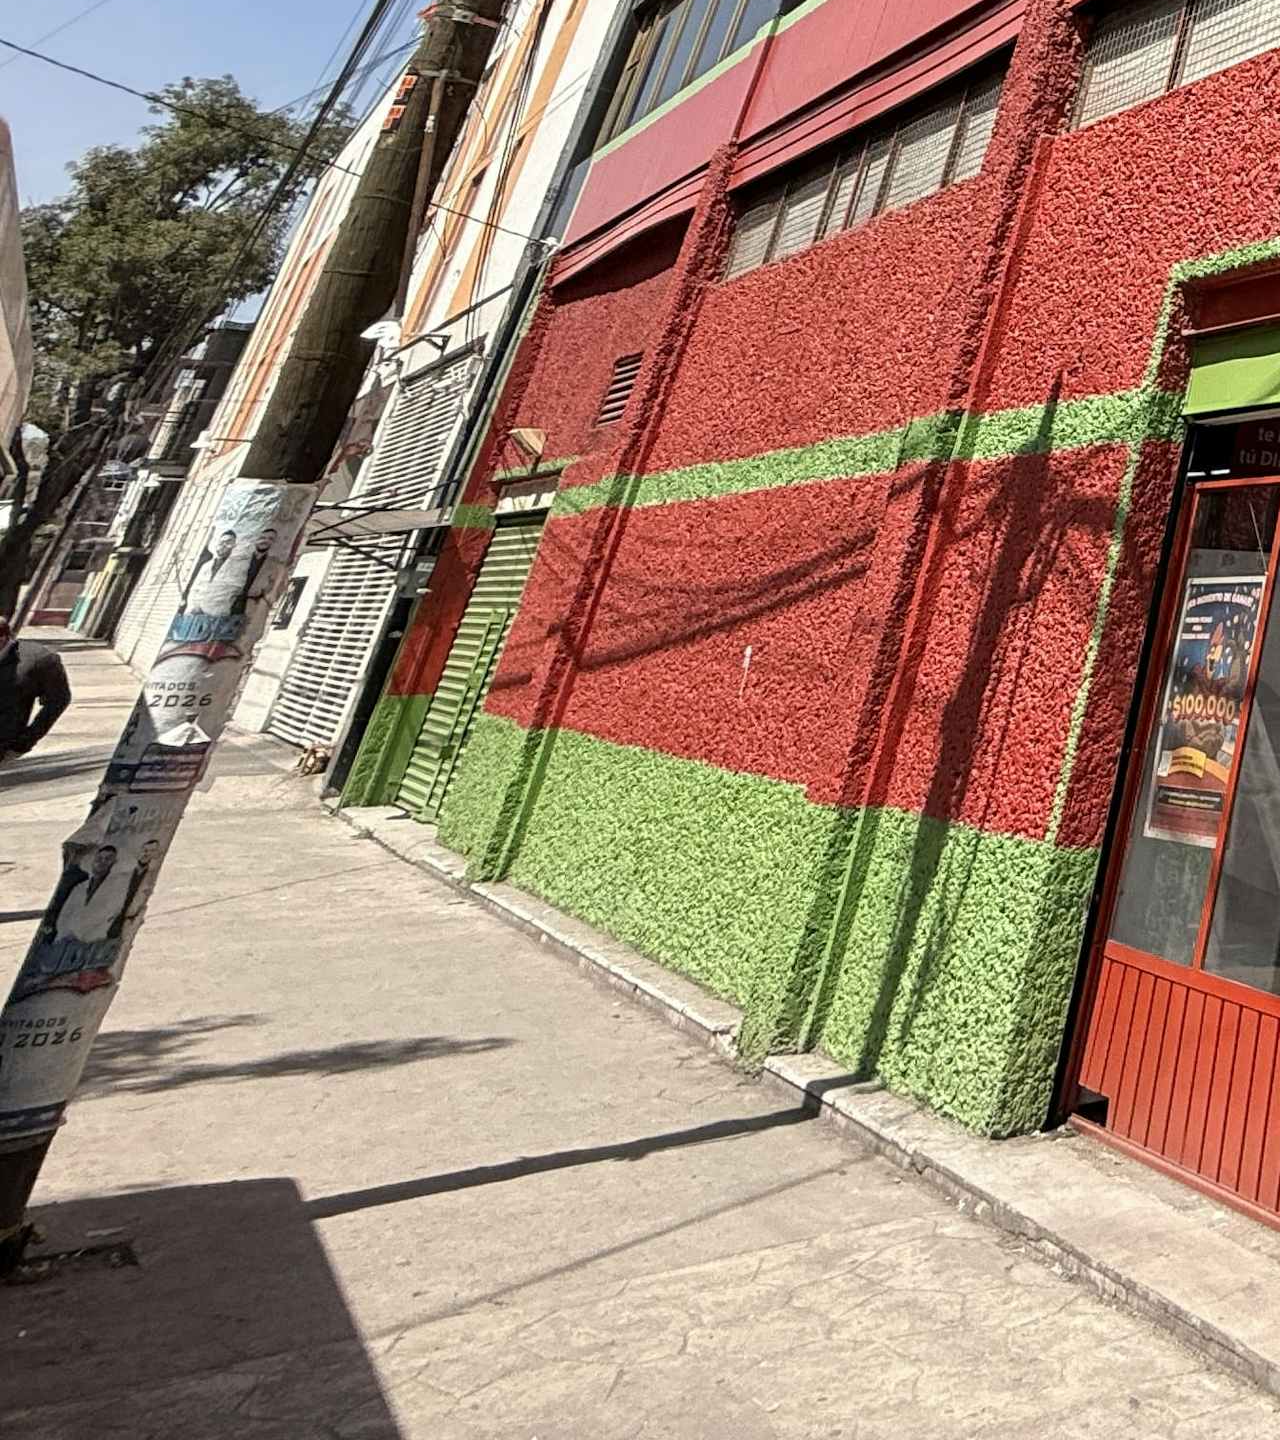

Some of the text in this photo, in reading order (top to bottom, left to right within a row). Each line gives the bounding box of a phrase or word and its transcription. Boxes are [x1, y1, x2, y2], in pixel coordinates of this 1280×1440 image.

[1257, 426, 1273, 442] te
[151, 693, 213, 708] 2026
[14, 1027, 83, 1049] 2026
